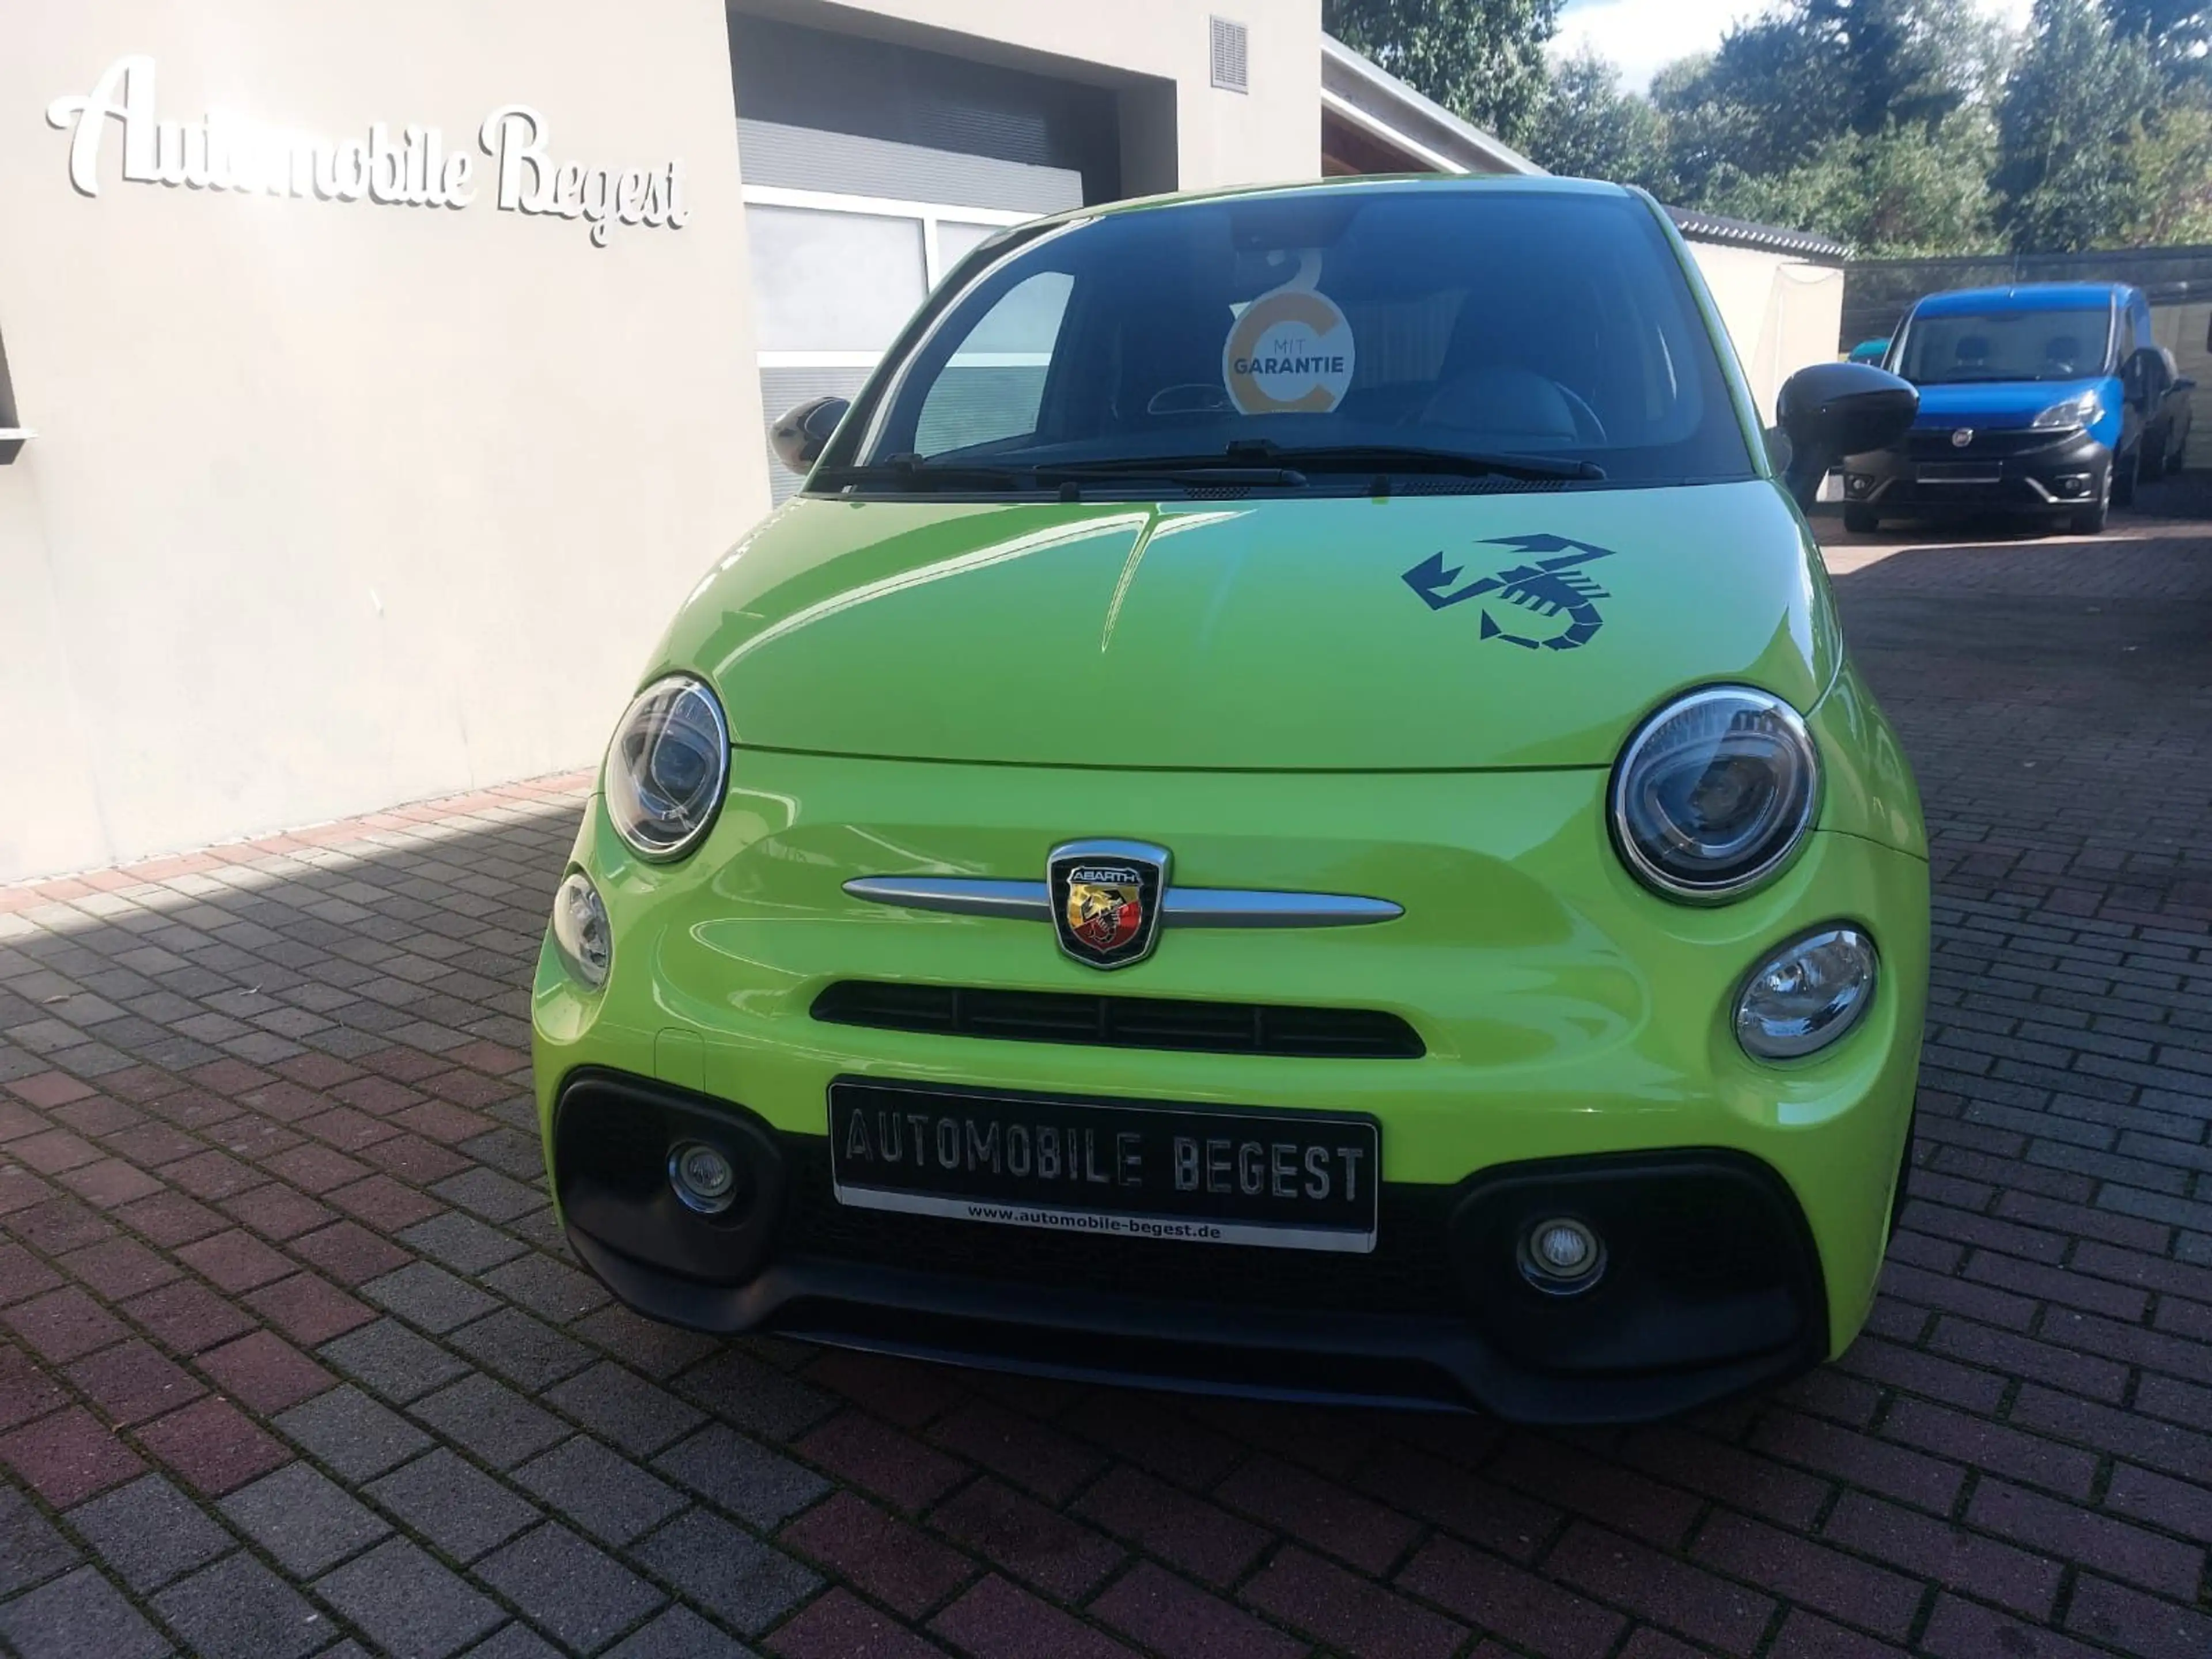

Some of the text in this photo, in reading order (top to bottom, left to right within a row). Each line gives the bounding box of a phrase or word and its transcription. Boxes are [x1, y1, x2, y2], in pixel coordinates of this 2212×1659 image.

[46, 54, 690, 248] Autmobile Begest
[1275, 339, 1305, 354] MIT
[1234, 357, 1343, 374] GARANTIE
[1074, 871, 1135, 882] ABARTH
[845, 1108, 1364, 1202] AUTOMOBILE BEGEST
[968, 1205, 1221, 1238] www.automobile-begest.de
